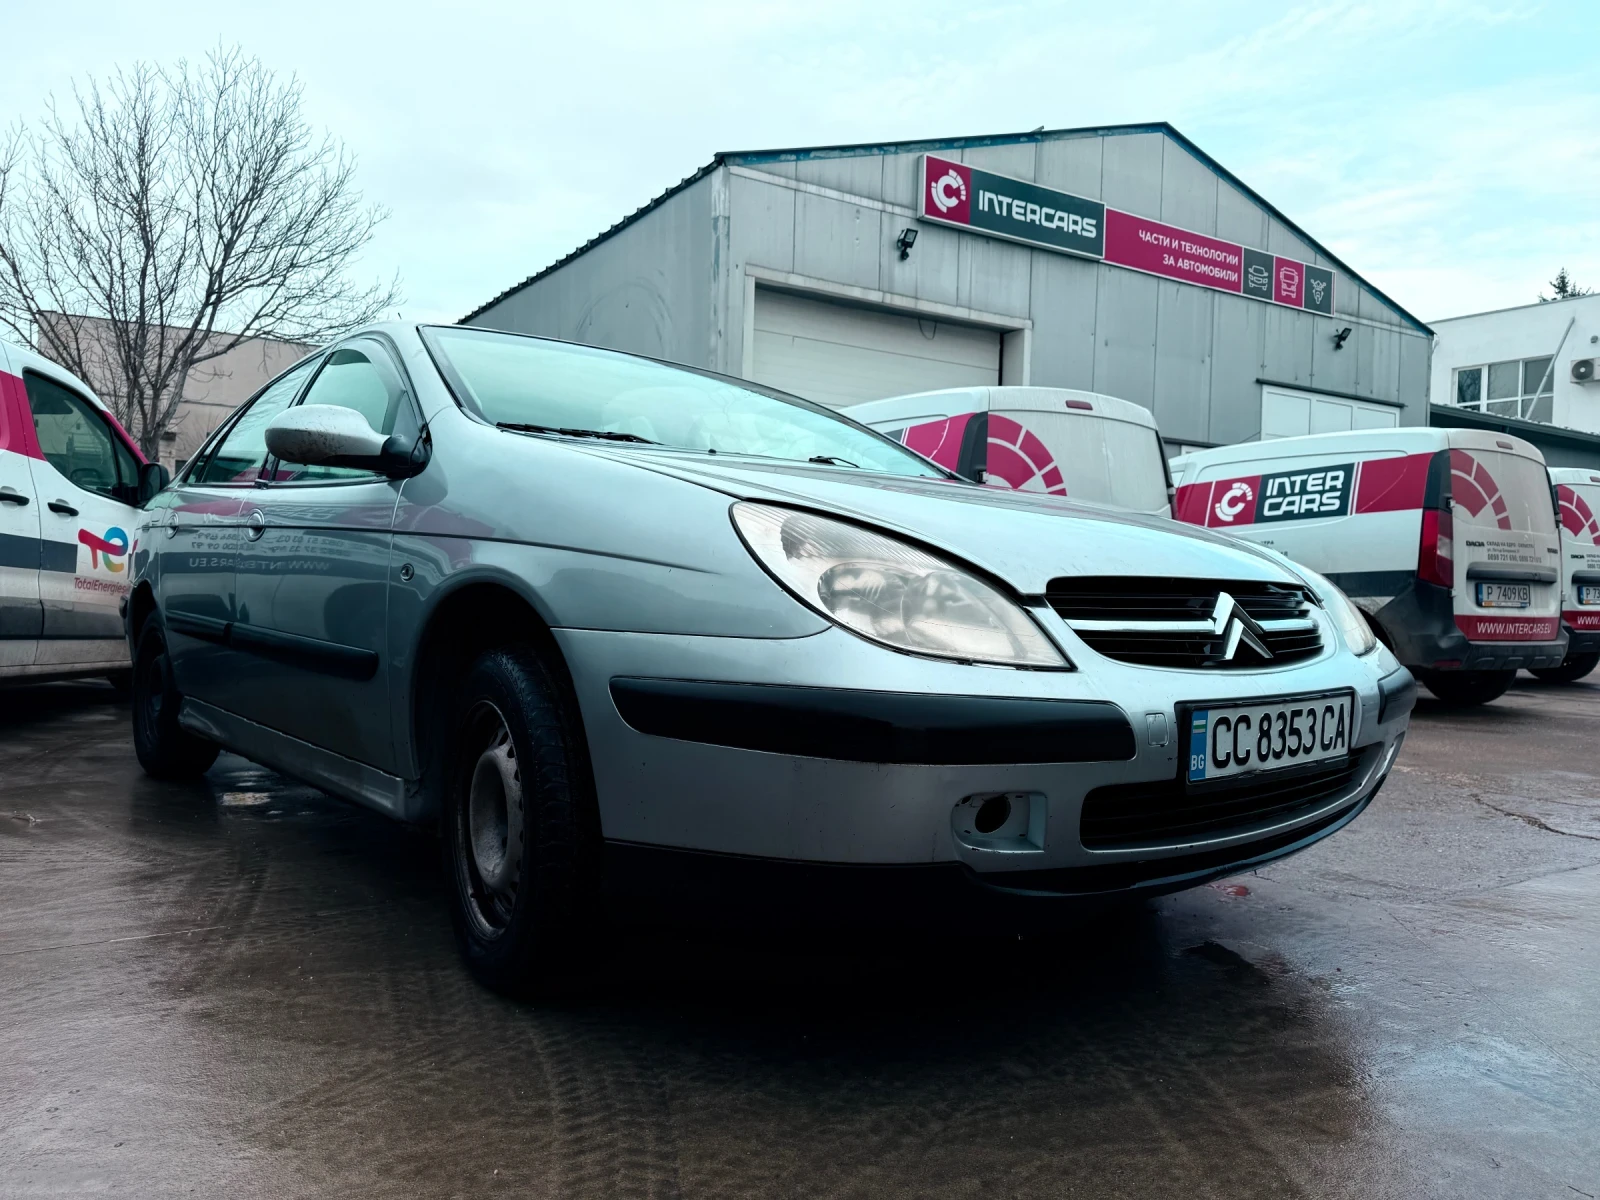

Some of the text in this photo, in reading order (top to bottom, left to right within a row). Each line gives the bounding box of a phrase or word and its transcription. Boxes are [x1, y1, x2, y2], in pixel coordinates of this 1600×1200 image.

[979, 189, 1097, 238] INTERCARS
[1139, 229, 1239, 266] ЧАСТИ И ТЕХНОЛОГИИ
[1162, 253, 1238, 282] ЗА АВТОМОБИЛИ
[1266, 470, 1345, 497] INTER
[1263, 491, 1341, 516] CARS
[74, 577, 127, 596] TotalEnergies
[1487, 585, 1528, 601] P 7409 KB
[1586, 588, 1591, 599] P
[1477, 622, 1552, 635] WWW.INTERCARS.EU
[1212, 703, 1346, 768] CC 8353 CA
[1190, 754, 1205, 771] BG
